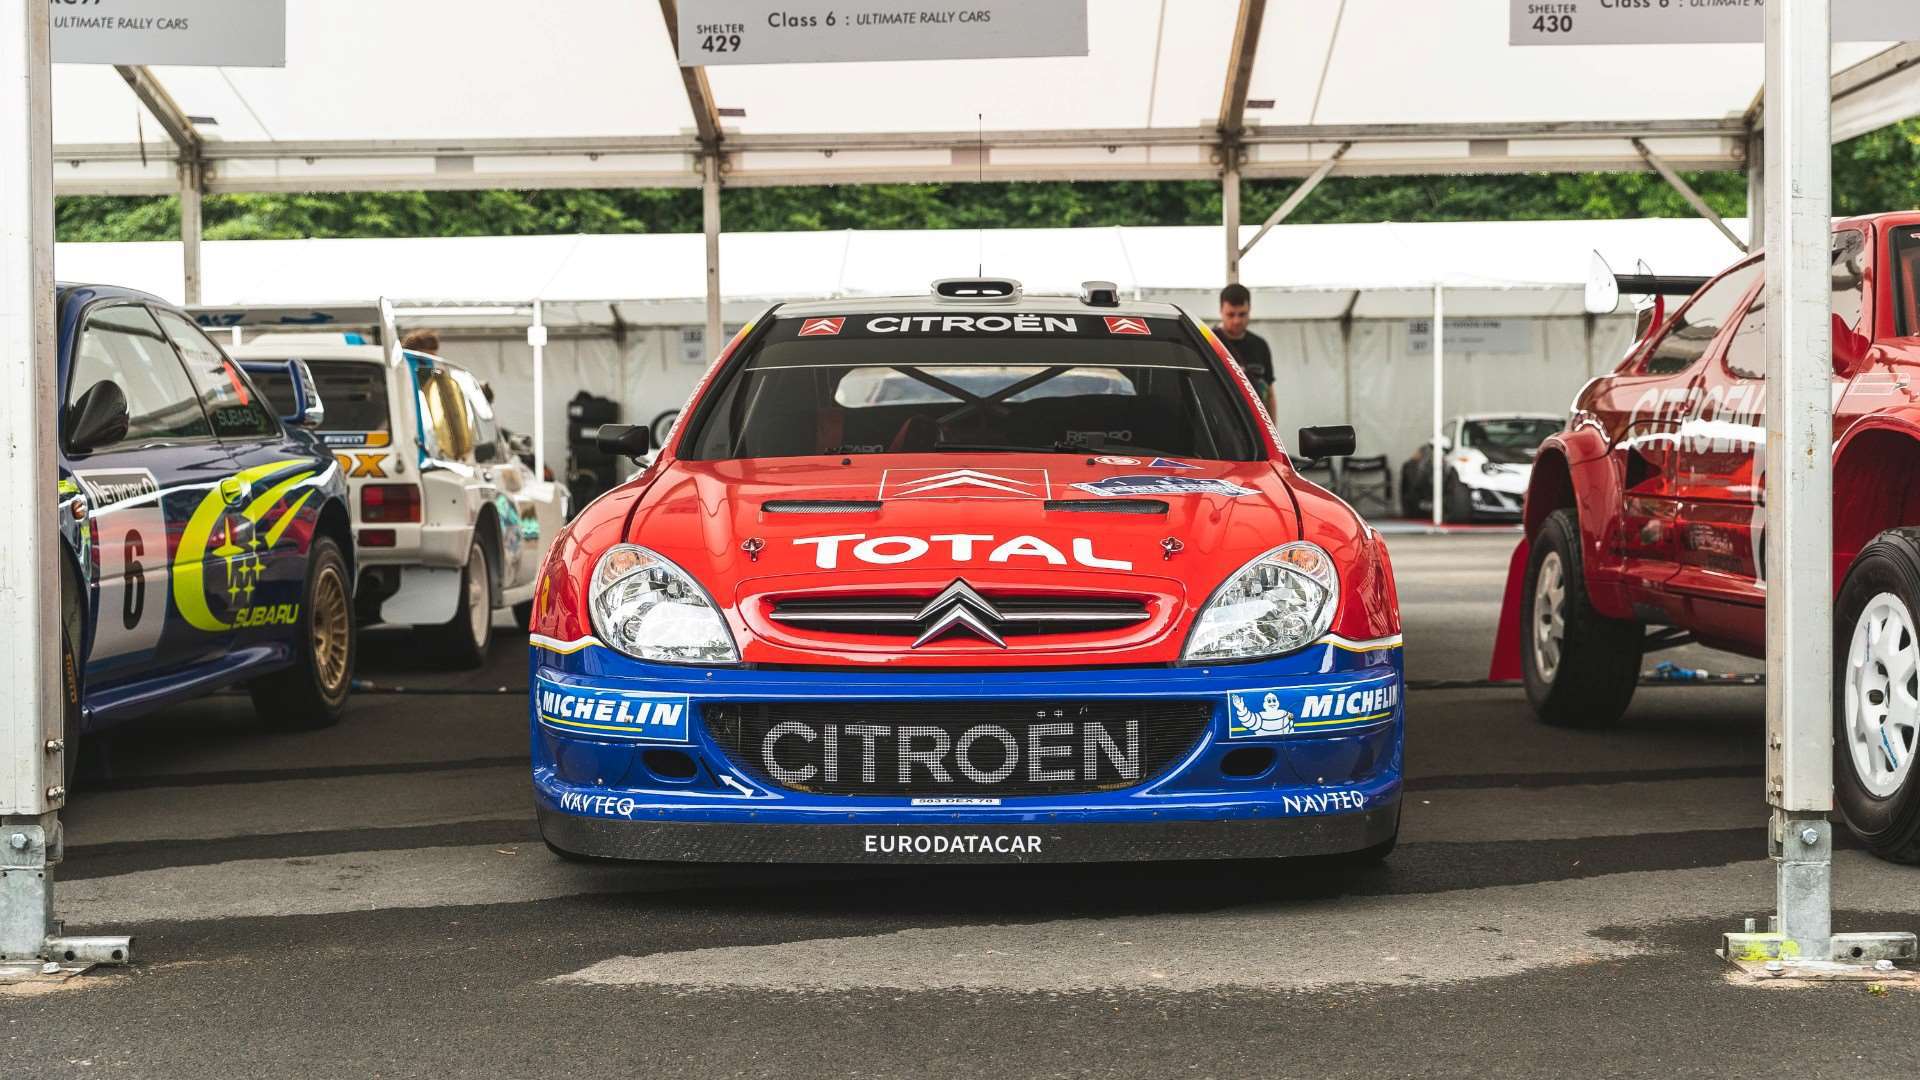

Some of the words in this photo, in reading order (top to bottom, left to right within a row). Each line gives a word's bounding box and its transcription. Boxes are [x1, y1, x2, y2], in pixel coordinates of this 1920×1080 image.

[1528, 3, 1577, 14] SHELTER
[54, 16, 114, 29] ULTIMATE
[117, 17, 153, 30] RALLY
[156, 17, 189, 30] CARS
[767, 12, 817, 28] Class
[825, 11, 836, 26] 6
[856, 12, 916, 26] ULTIMATE
[919, 11, 955, 24] RALLY
[958, 10, 991, 23] CARS
[1532, 15, 1573, 32] 430
[696, 24, 745, 34] SHELTER
[701, 35, 741, 52] 429
[866, 314, 1078, 333] CITROËN
[793, 533, 1133, 571] TOTAL
[123, 529, 145, 630] 6
[234, 603, 299, 627] SUBARU
[543, 691, 684, 726] MICHELIN
[761, 711, 1139, 784] CITROËN
[560, 791, 635, 820] NAVTEQ
[1282, 790, 1365, 813] NAVTEQ
[864, 835, 1042, 853] EURODATACAR
